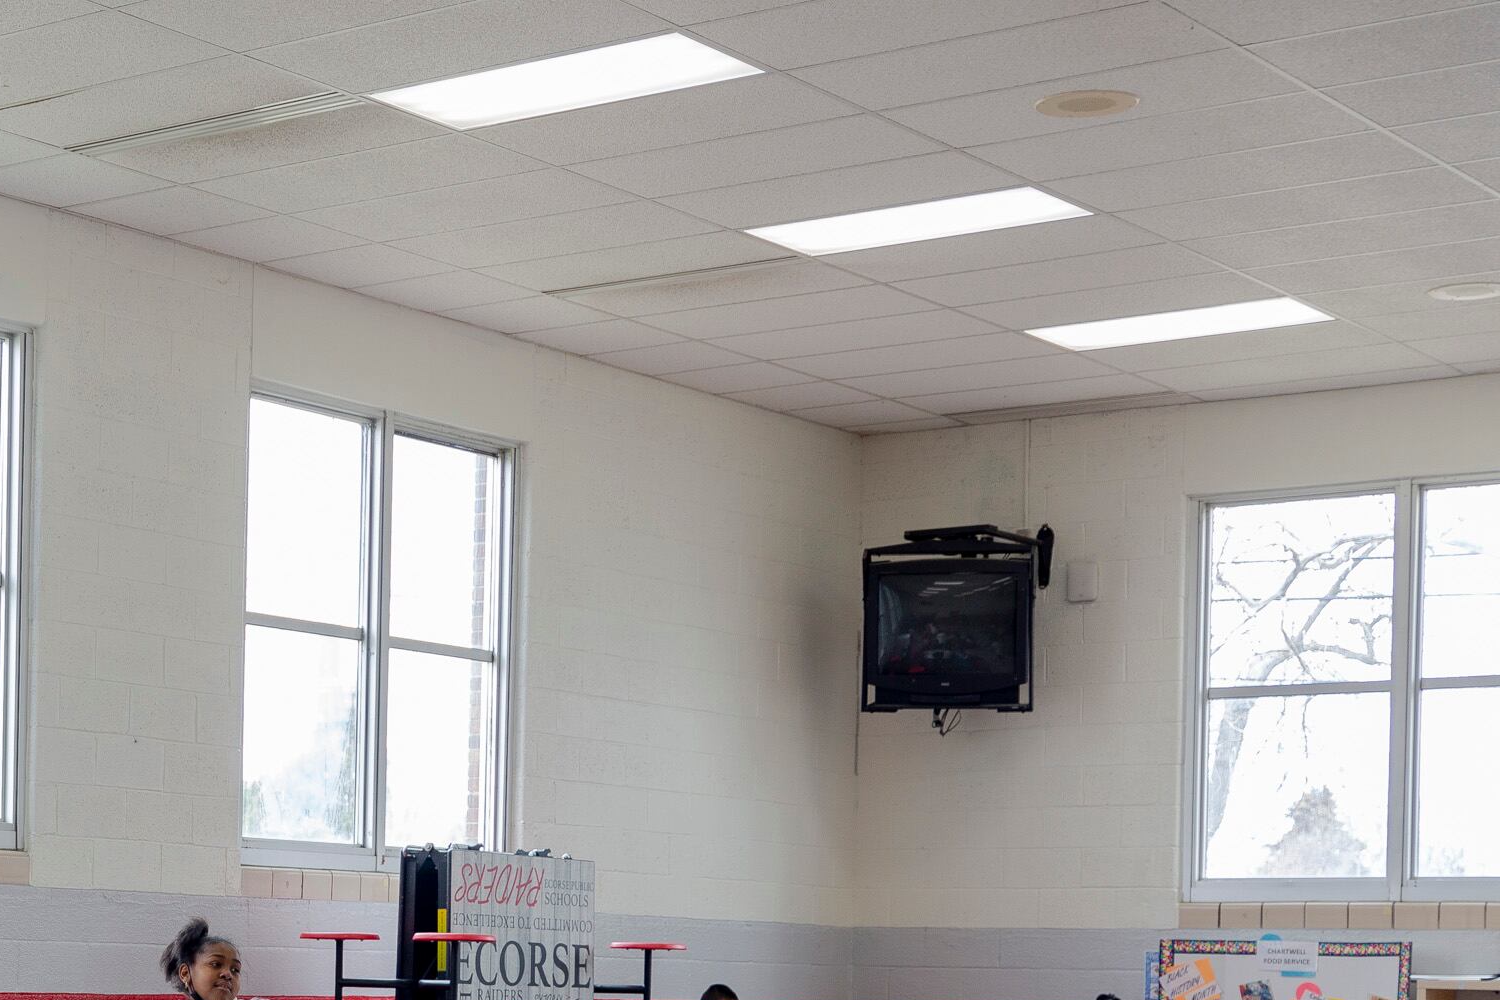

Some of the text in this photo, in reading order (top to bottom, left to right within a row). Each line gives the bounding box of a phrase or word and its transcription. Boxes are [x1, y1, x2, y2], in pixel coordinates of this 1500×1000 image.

[454, 863, 545, 907] RAIDERS
[544, 879, 569, 890] ECORSE
[544, 891, 589, 908] SCHOOLS
[452, 912, 593, 934] COMMITTED TO EXCELLENCE
[457, 940, 591, 988] ECORSE
[1263, 957, 1310, 966] FOOD SERVICE
[1166, 964, 1189, 984] BLACK
[1170, 975, 1201, 998] HISTORY
